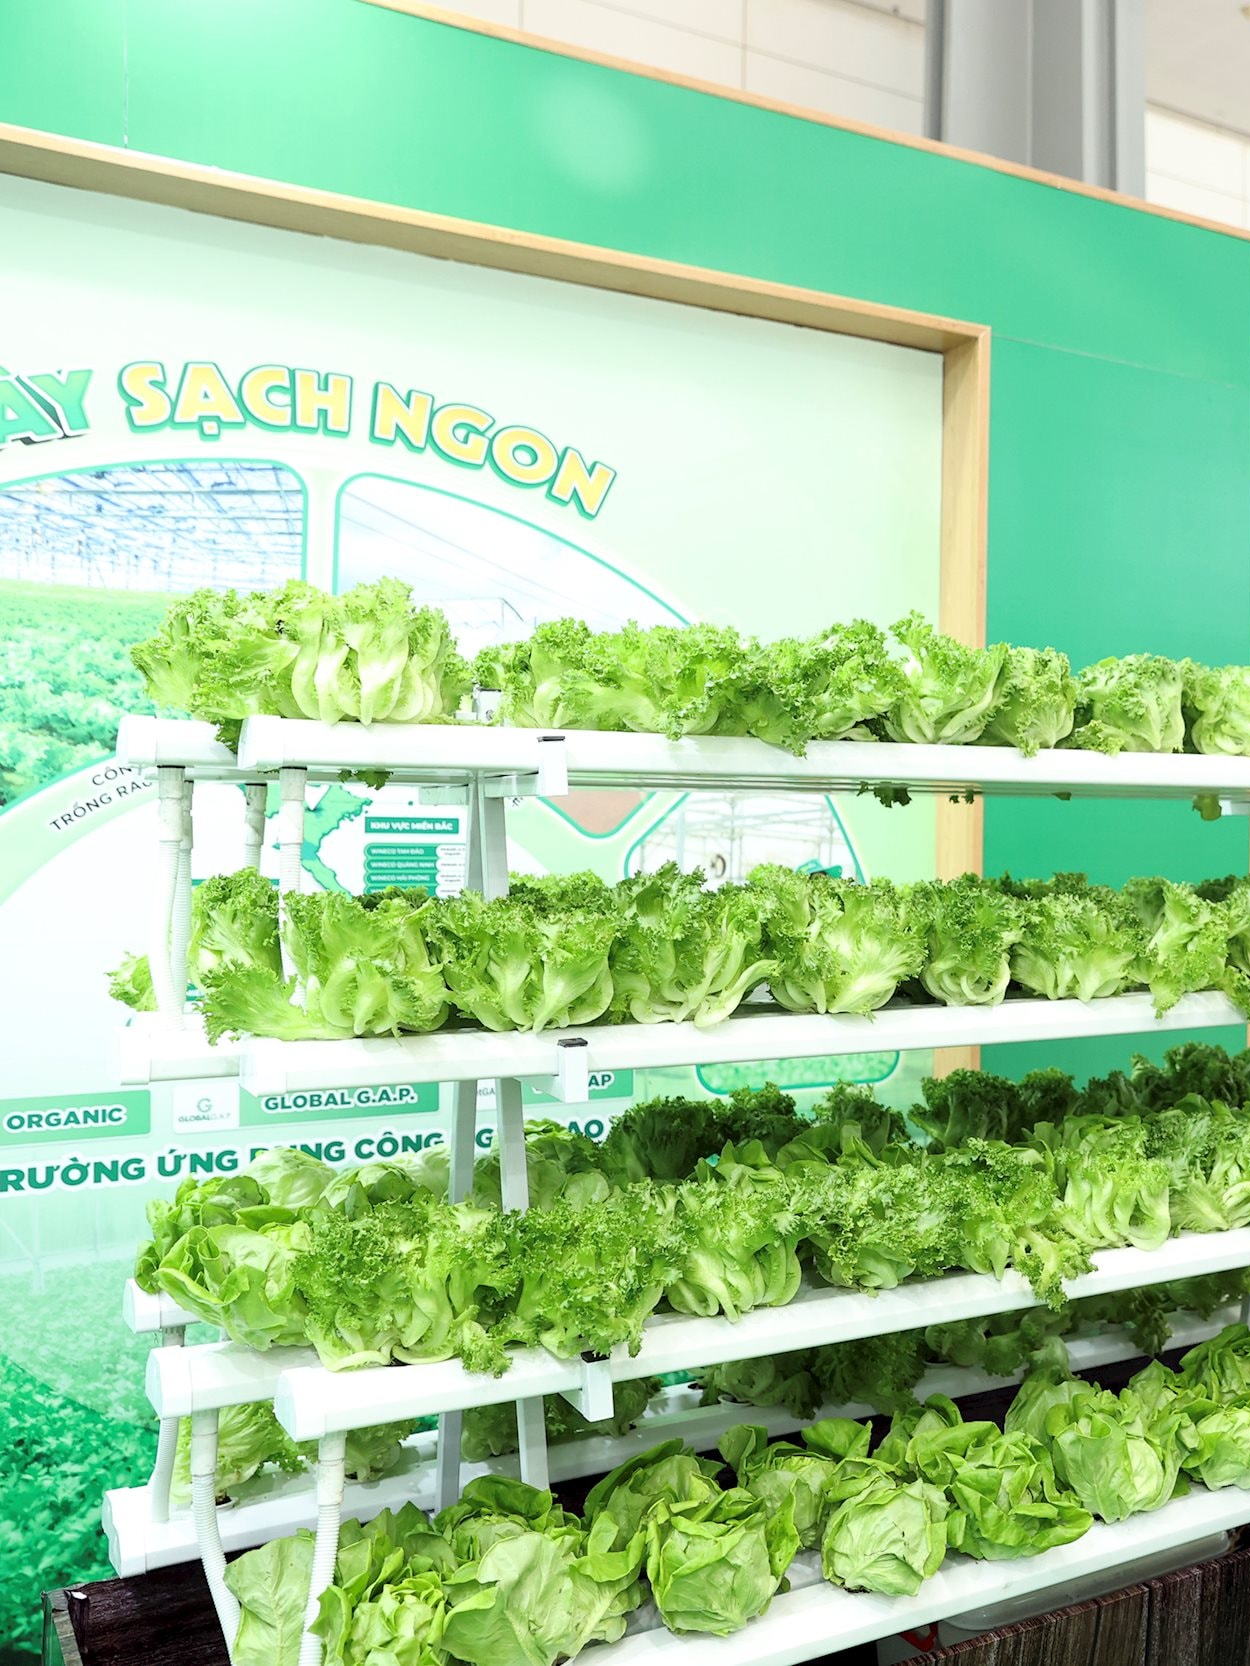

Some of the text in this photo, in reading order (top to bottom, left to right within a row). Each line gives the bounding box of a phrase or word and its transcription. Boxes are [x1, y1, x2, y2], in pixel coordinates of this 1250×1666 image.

[118, 361, 353, 441] SẠCH
[369, 381, 618, 520] NGON
[370, 821, 453, 831] KHU VỰC MIỀN BẮC
[264, 1088, 415, 1111] GLOBAL G.A.P.
[6, 1107, 123, 1130] ORGANIC
[0, 1157, 146, 1193] RƯỜNG
[157, 1149, 239, 1177] ỨNG
[354, 1131, 445, 1160] CÔNG
